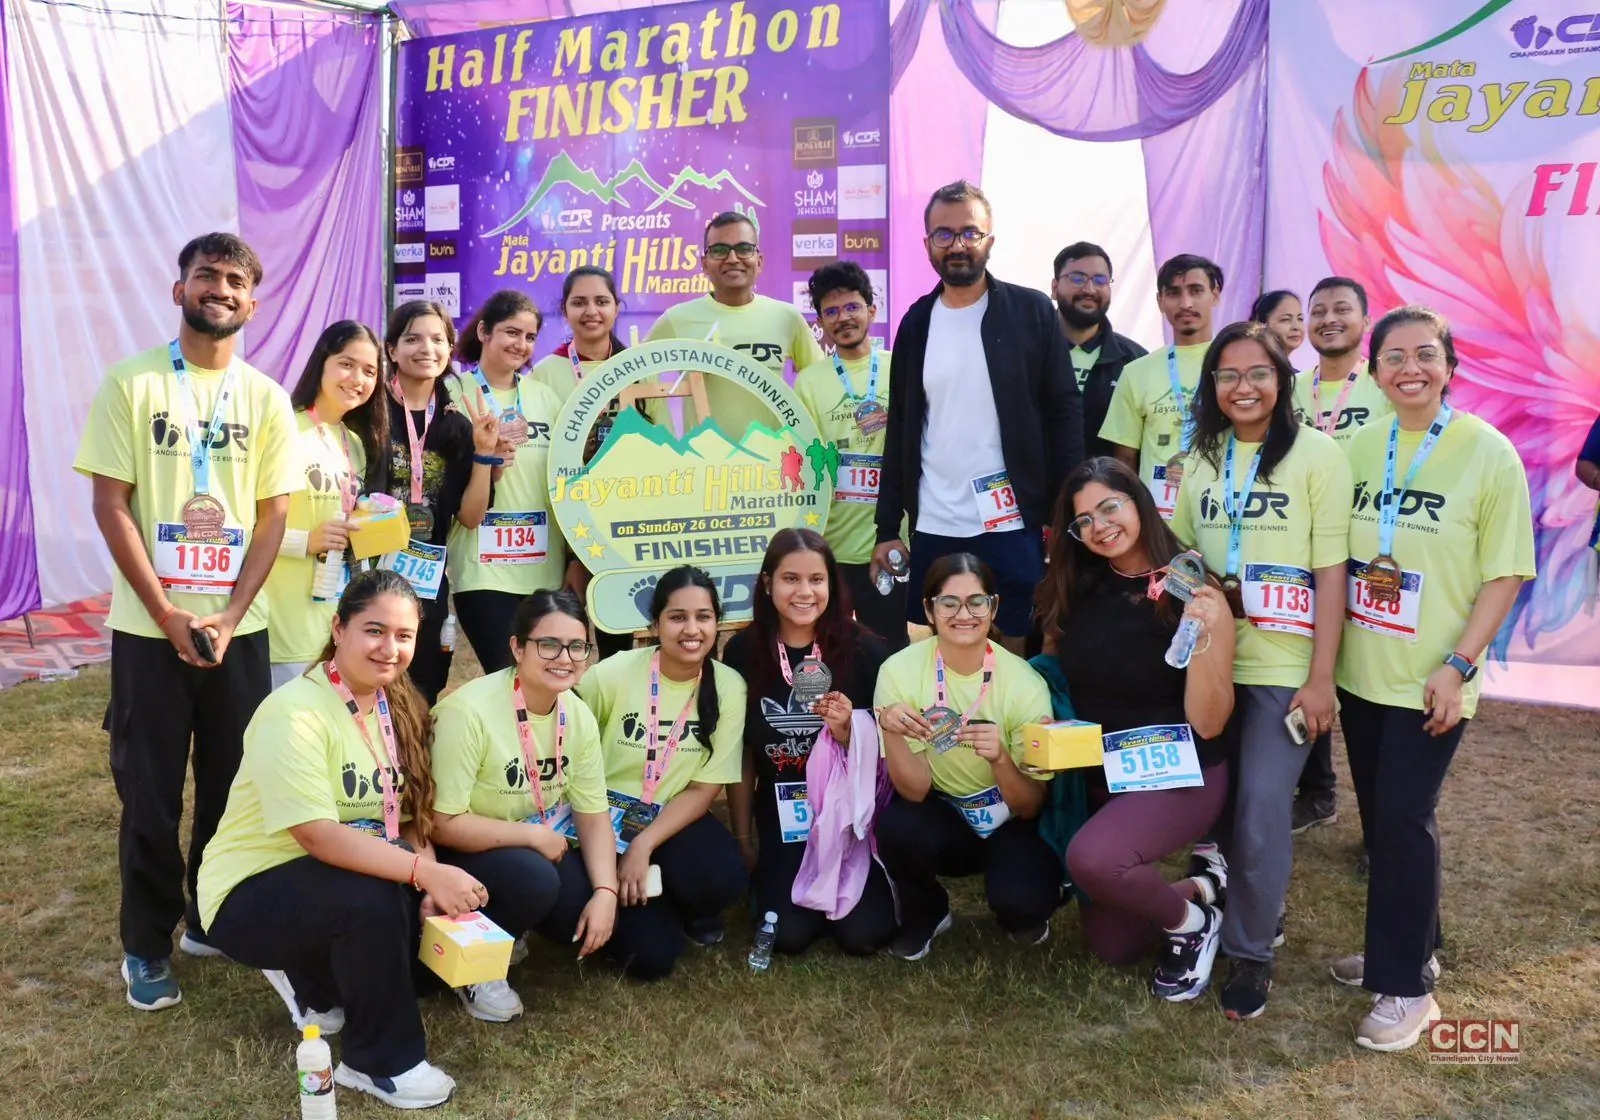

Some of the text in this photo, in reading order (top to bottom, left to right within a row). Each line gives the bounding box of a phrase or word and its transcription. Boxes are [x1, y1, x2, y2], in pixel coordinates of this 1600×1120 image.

[425, 1, 841, 92] Half Marathon
[1409, 60, 1476, 80] Mata
[504, 65, 749, 142] FINISHER
[437, 156, 455, 168] CDR
[794, 190, 836, 207] SHAM
[1525, 162, 1600, 216] FI
[395, 206, 424, 221] SHAM
[557, 208, 672, 232] CDR Presents
[797, 206, 835, 216] JEWELLERS
[502, 234, 529, 247] Mata
[795, 237, 835, 249] verka
[395, 245, 424, 257] verka
[494, 236, 699, 294] Jayanti Hills
[645, 272, 715, 294] Marath
[564, 348, 801, 442] CHANDIGARH DISTANCE RUNNERS
[557, 466, 590, 477] Mata
[850, 468, 879, 488] 113
[552, 463, 781, 512] Jayanti Hills
[730, 492, 817, 511] Marathon
[990, 486, 1016, 510] 13
[617, 525, 634, 535] on
[637, 520, 686, 534] Sunday
[689, 519, 706, 531] 26
[738, 514, 770, 528] 2025
[1407, 523, 1439, 535] RUNNERS
[494, 527, 536, 547] 1134
[176, 544, 231, 573] 1136
[634, 535, 769, 562] FINISHER
[391, 553, 437, 582] 5145
[1260, 583, 1309, 614] 1133
[617, 740, 646, 749] CHANDIGA
[1120, 743, 1181, 775] 5158
[964, 808, 994, 826] 54
